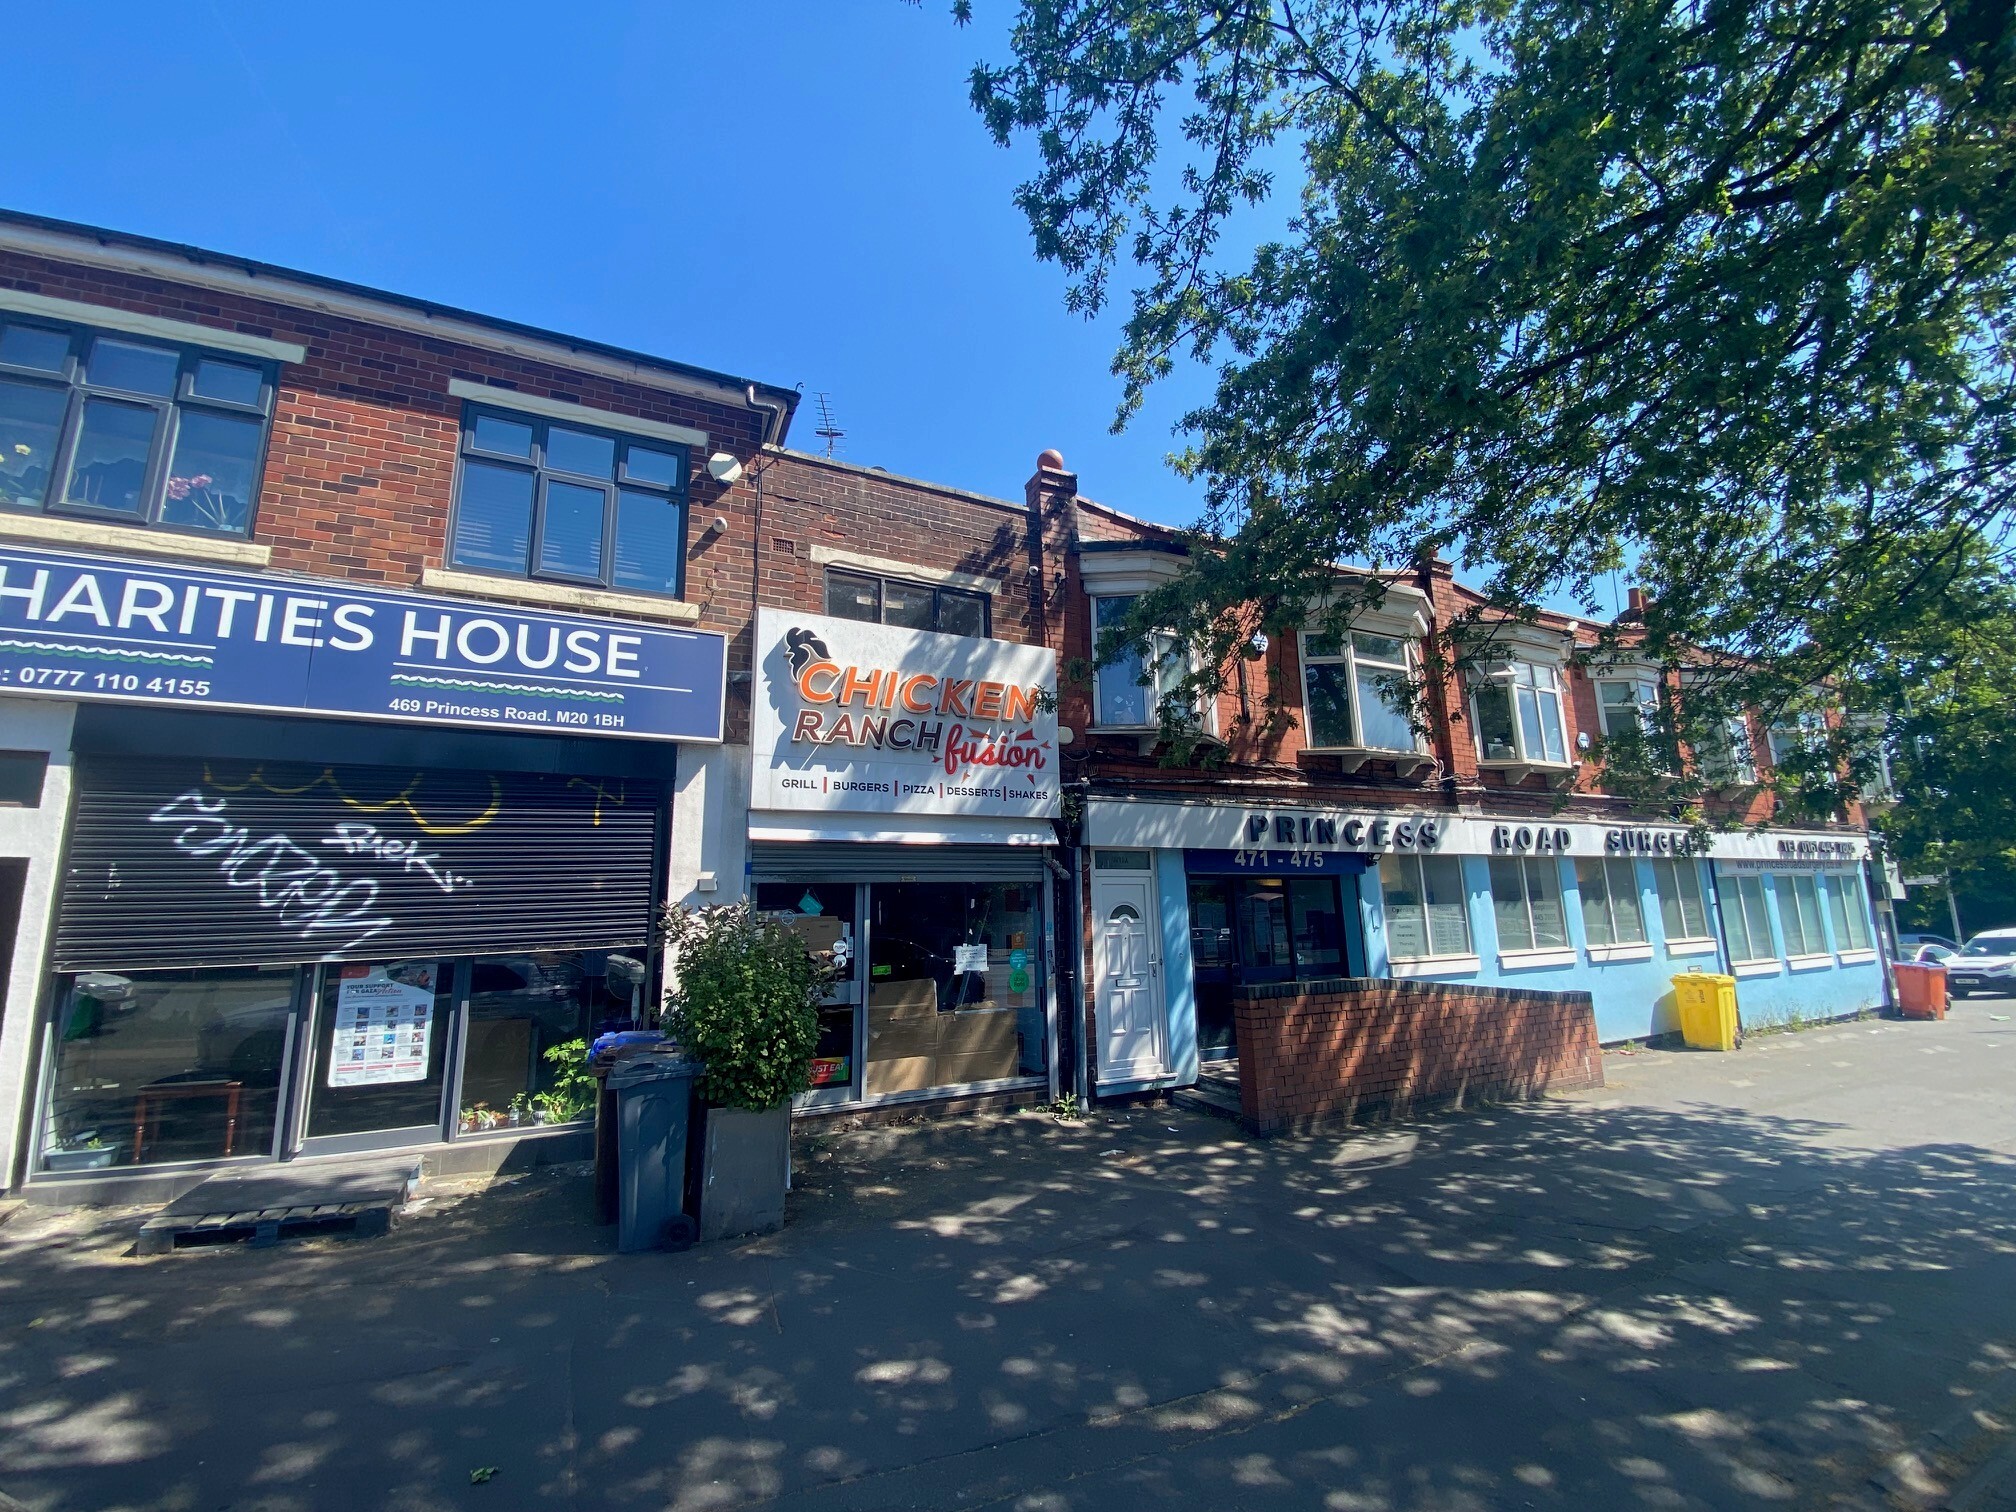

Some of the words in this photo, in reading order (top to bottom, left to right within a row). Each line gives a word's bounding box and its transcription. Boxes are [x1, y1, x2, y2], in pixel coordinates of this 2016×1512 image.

[400, 610, 642, 679] HOUSE
[19, 667, 86, 688] 0777
[94, 672, 139, 691] 110
[145, 676, 210, 697] 4155
[797, 661, 1039, 724] CHICKEN
[388, 697, 421, 713] 469
[425, 702, 500, 719] Princess
[504, 706, 552, 723] Road.
[556, 710, 588, 725] M20
[593, 713, 625, 728] 1BH
[791, 709, 944, 751] RANCH
[944, 723, 1047, 775] fusion
[781, 778, 818, 790] GRILL
[833, 780, 890, 793] BURGERS
[902, 784, 935, 796] PIZZA
[946, 786, 1001, 799] DESSERTS
[1008, 789, 1048, 801] SHAKES
[1248, 814, 1440, 849] PRINCESS
[1494, 825, 1573, 851] ROAD
[1234, 850, 1269, 868] 471
[1290, 850, 1325, 868] 475
